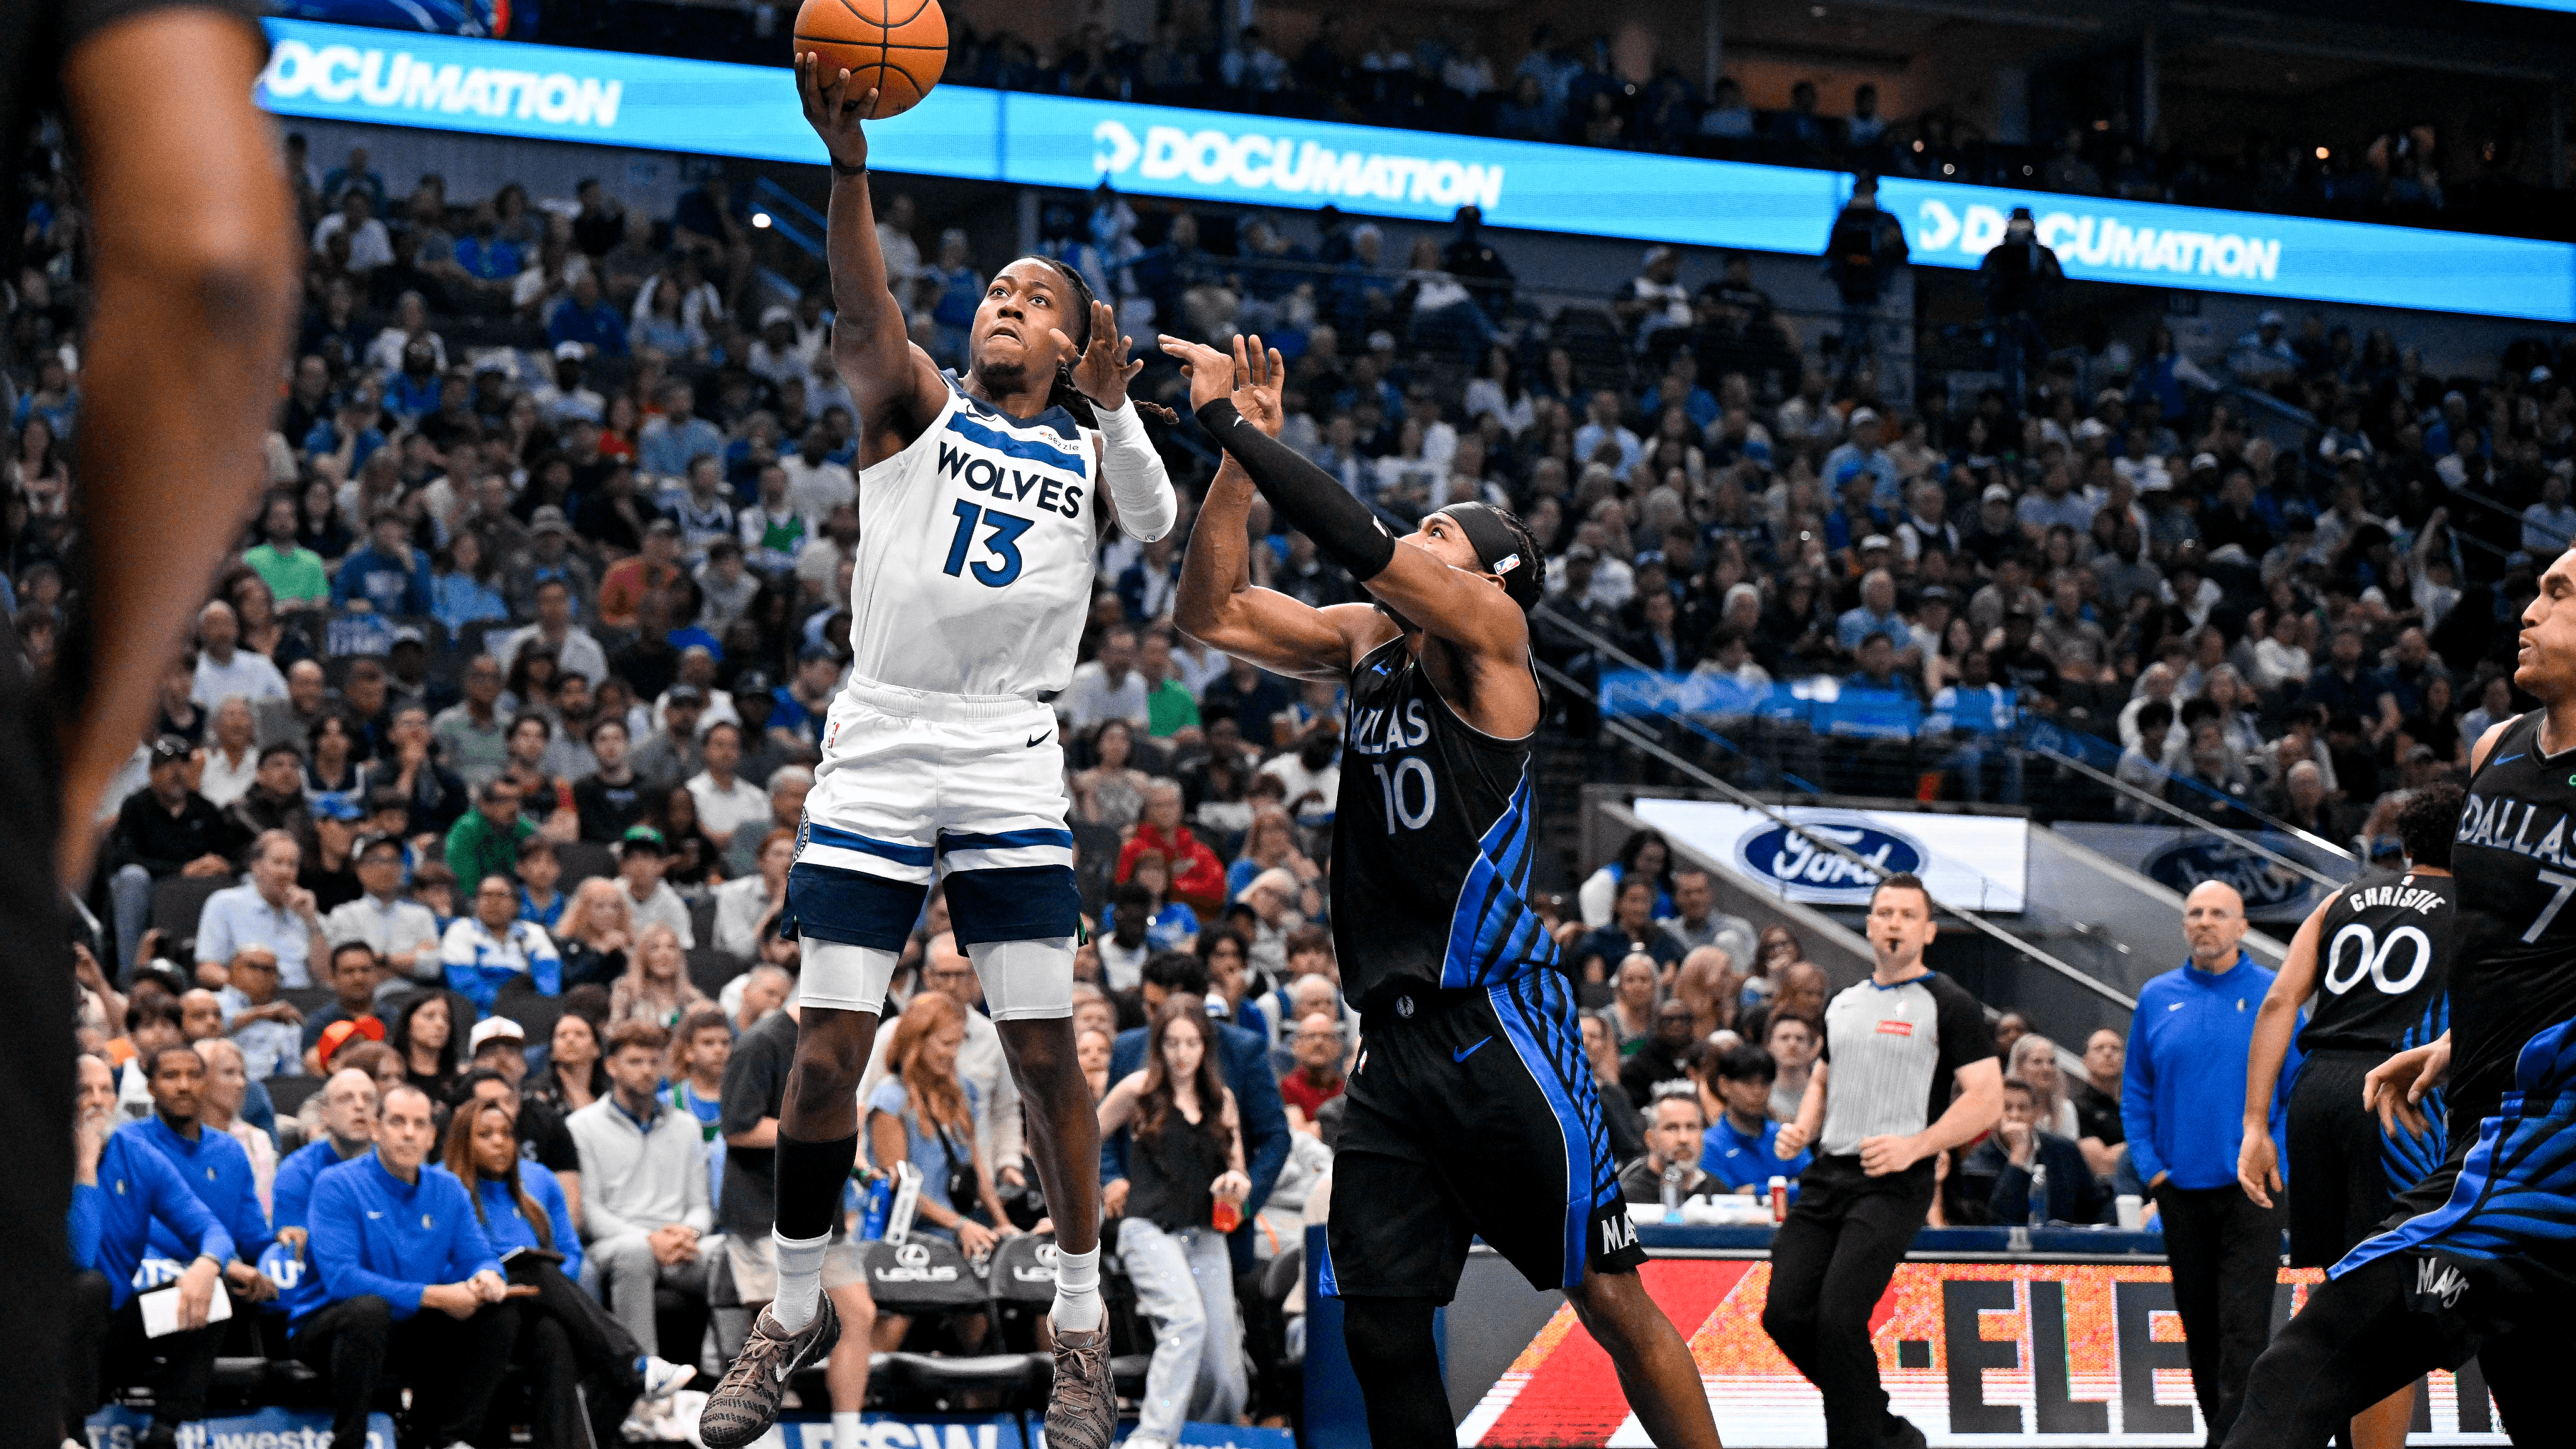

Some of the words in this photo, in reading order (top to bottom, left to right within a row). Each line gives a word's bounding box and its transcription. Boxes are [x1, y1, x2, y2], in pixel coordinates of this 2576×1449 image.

[268, 39, 624, 128] OCUMATION
[1140, 125, 1504, 208] DOCUMATION
[1960, 204, 2282, 280] DCUMATION
[1048, 433, 1079, 450] sezzle
[938, 441, 1084, 519] WOLVES
[943, 498, 1035, 588] 13
[1350, 697, 1430, 754] ALLAS
[1372, 757, 1436, 835] 10
[1772, 824, 1893, 881] Ford
[2350, 886, 2446, 915] CHRISTIE
[2520, 868, 2576, 944] 7
[2325, 923, 2431, 995] 00
[1601, 1211, 1639, 1255] MA
